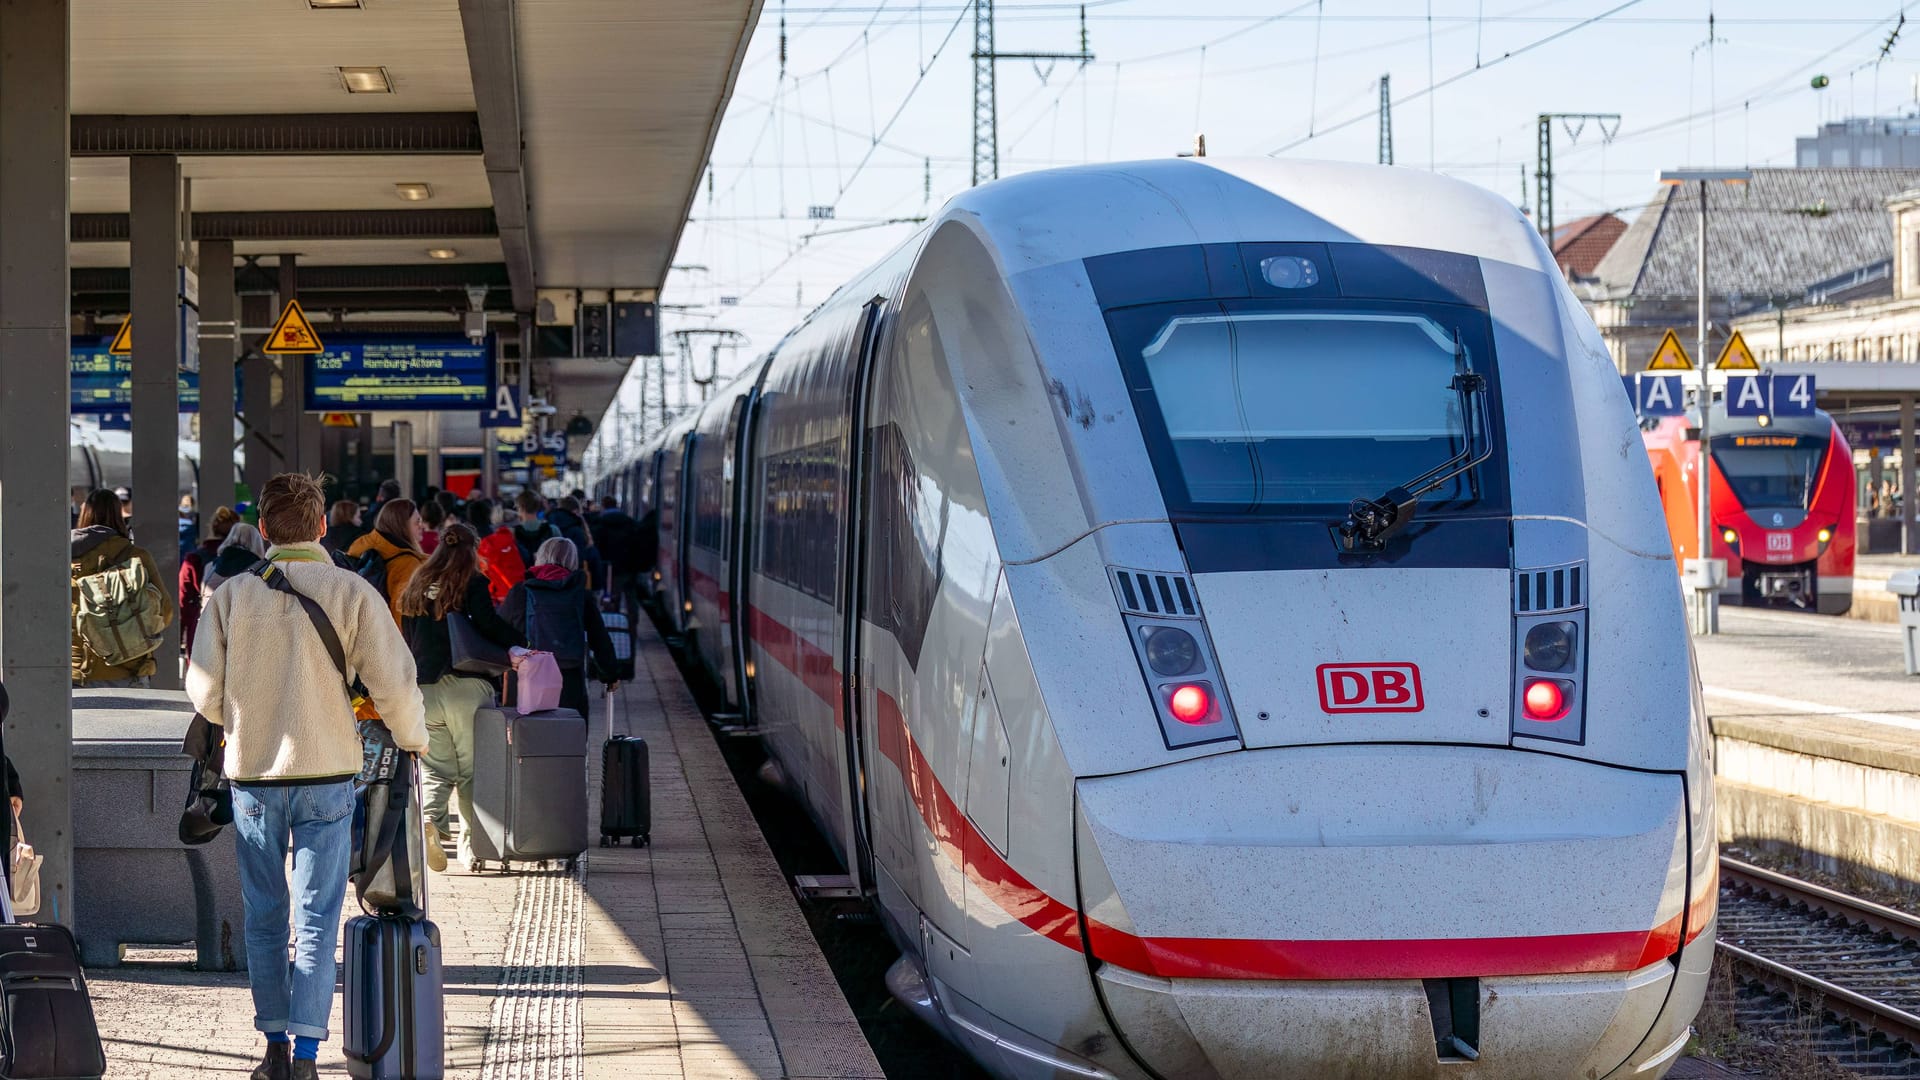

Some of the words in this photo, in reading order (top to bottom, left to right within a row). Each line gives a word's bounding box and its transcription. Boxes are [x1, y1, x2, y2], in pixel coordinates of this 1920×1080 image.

[362, 358, 443, 371] Hamburg-Altona
[489, 385, 518, 419] A
[1645, 375, 1674, 409] A
[1736, 375, 1766, 409] A
[1788, 374, 1811, 409] 4
[1328, 669, 1412, 706] DB
